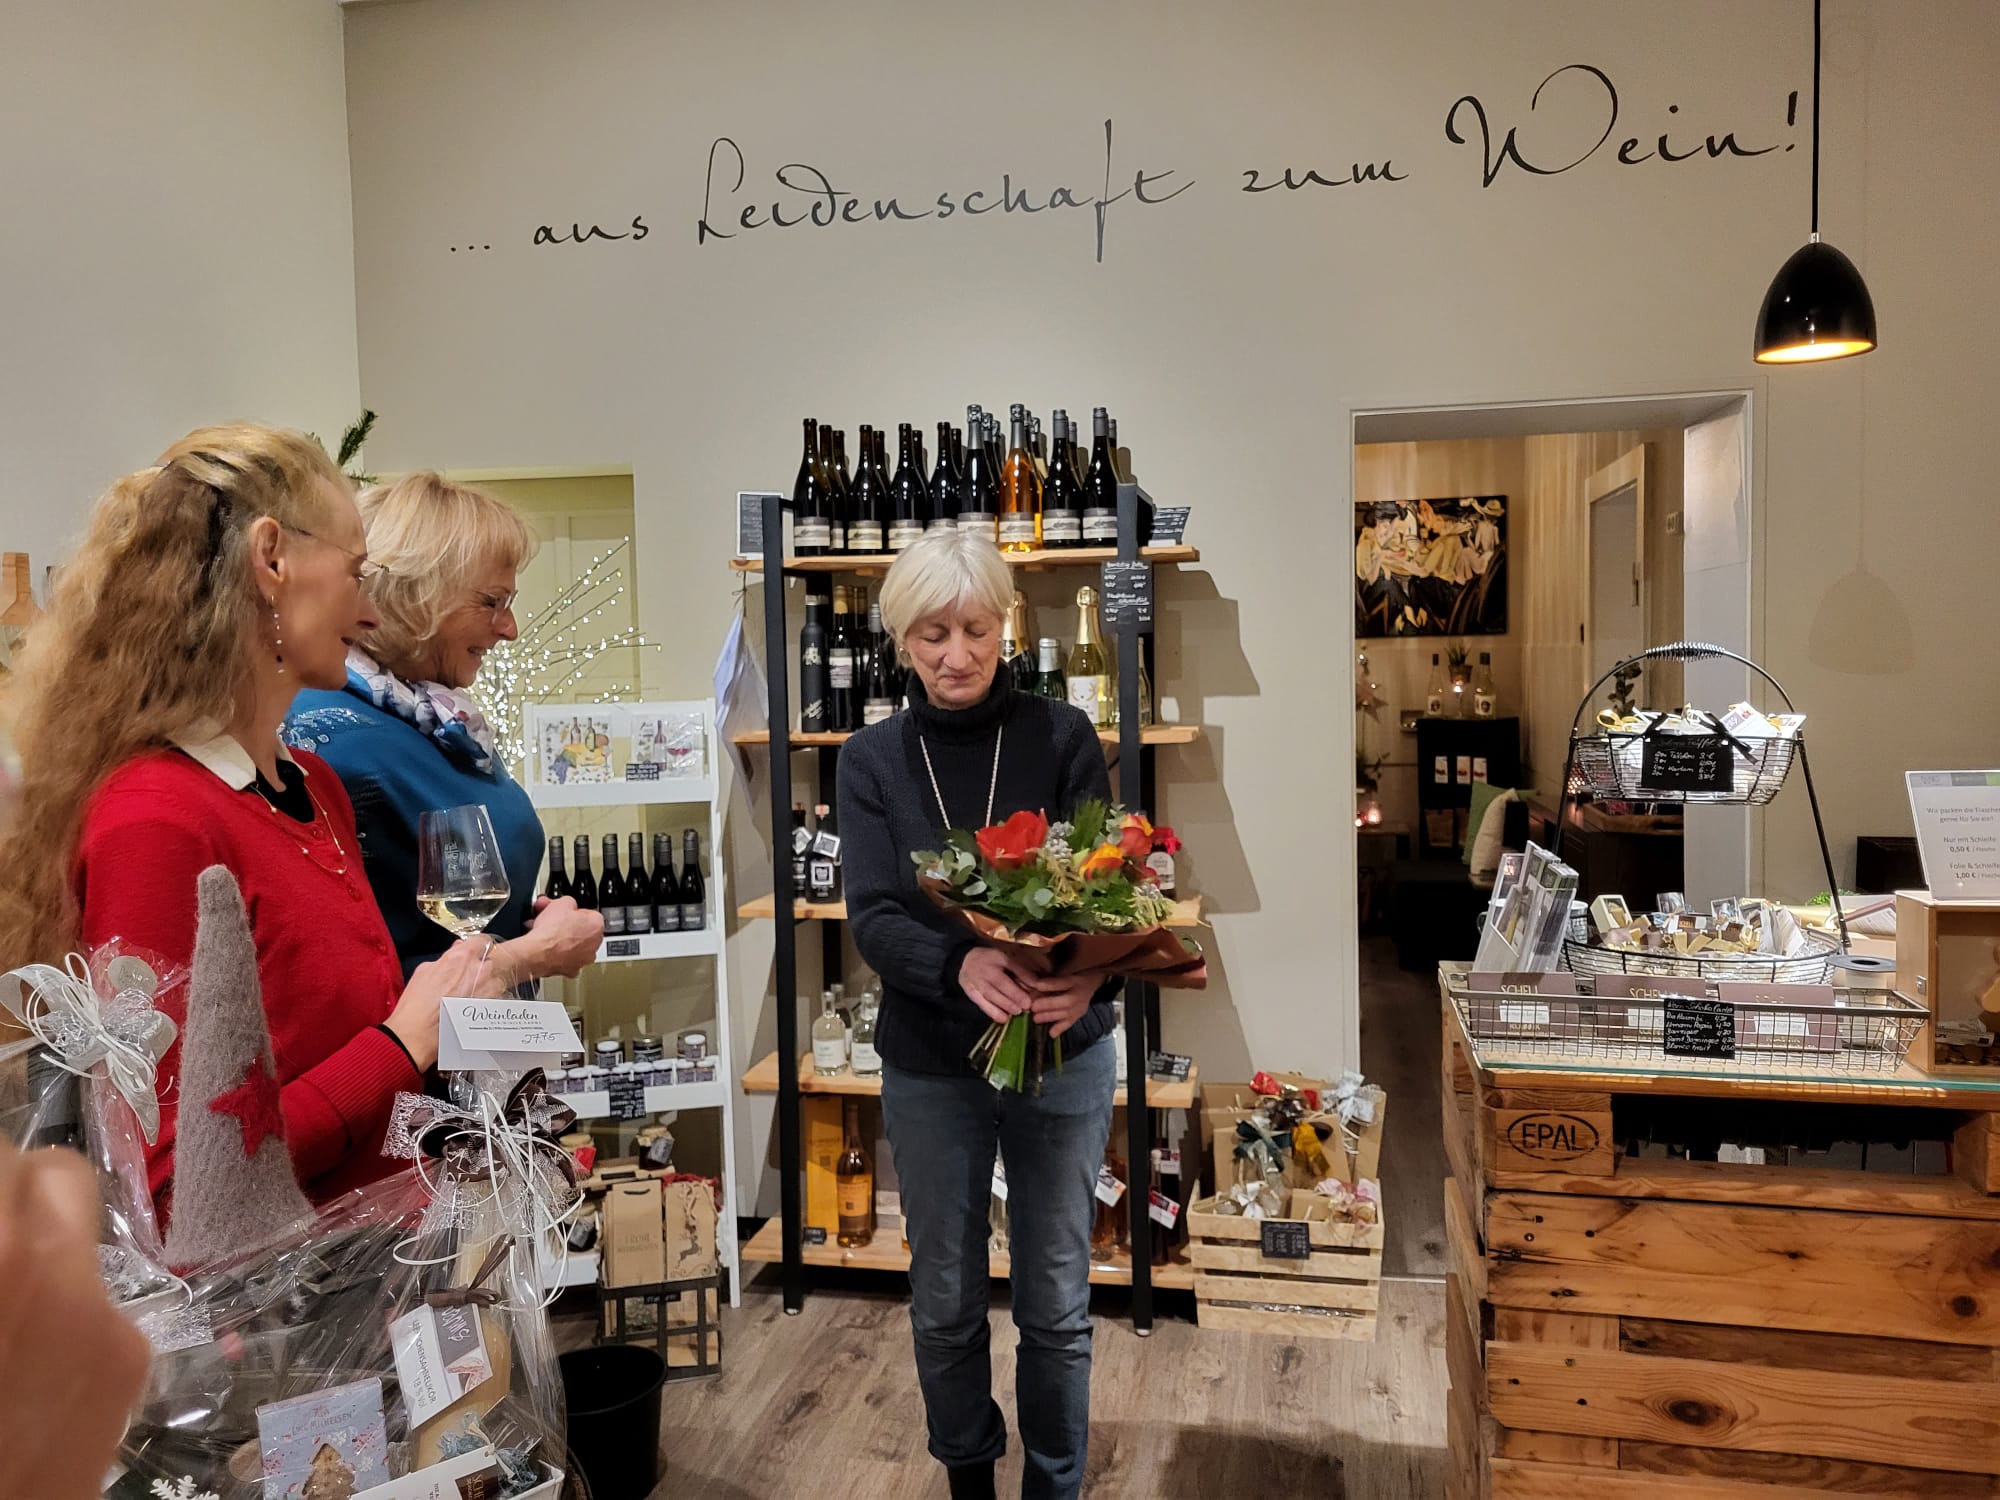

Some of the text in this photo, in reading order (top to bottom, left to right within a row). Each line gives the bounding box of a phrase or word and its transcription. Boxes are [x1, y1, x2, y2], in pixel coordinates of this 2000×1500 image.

[533, 214, 650, 246] aus
[698, 118, 1196, 264] Leidenschaft
[1242, 158, 1410, 192] zum
[1444, 64, 1799, 189] Wein!
[462, 1005, 538, 1022] Weinladen
[1521, 1122, 1586, 1152] EPAL
